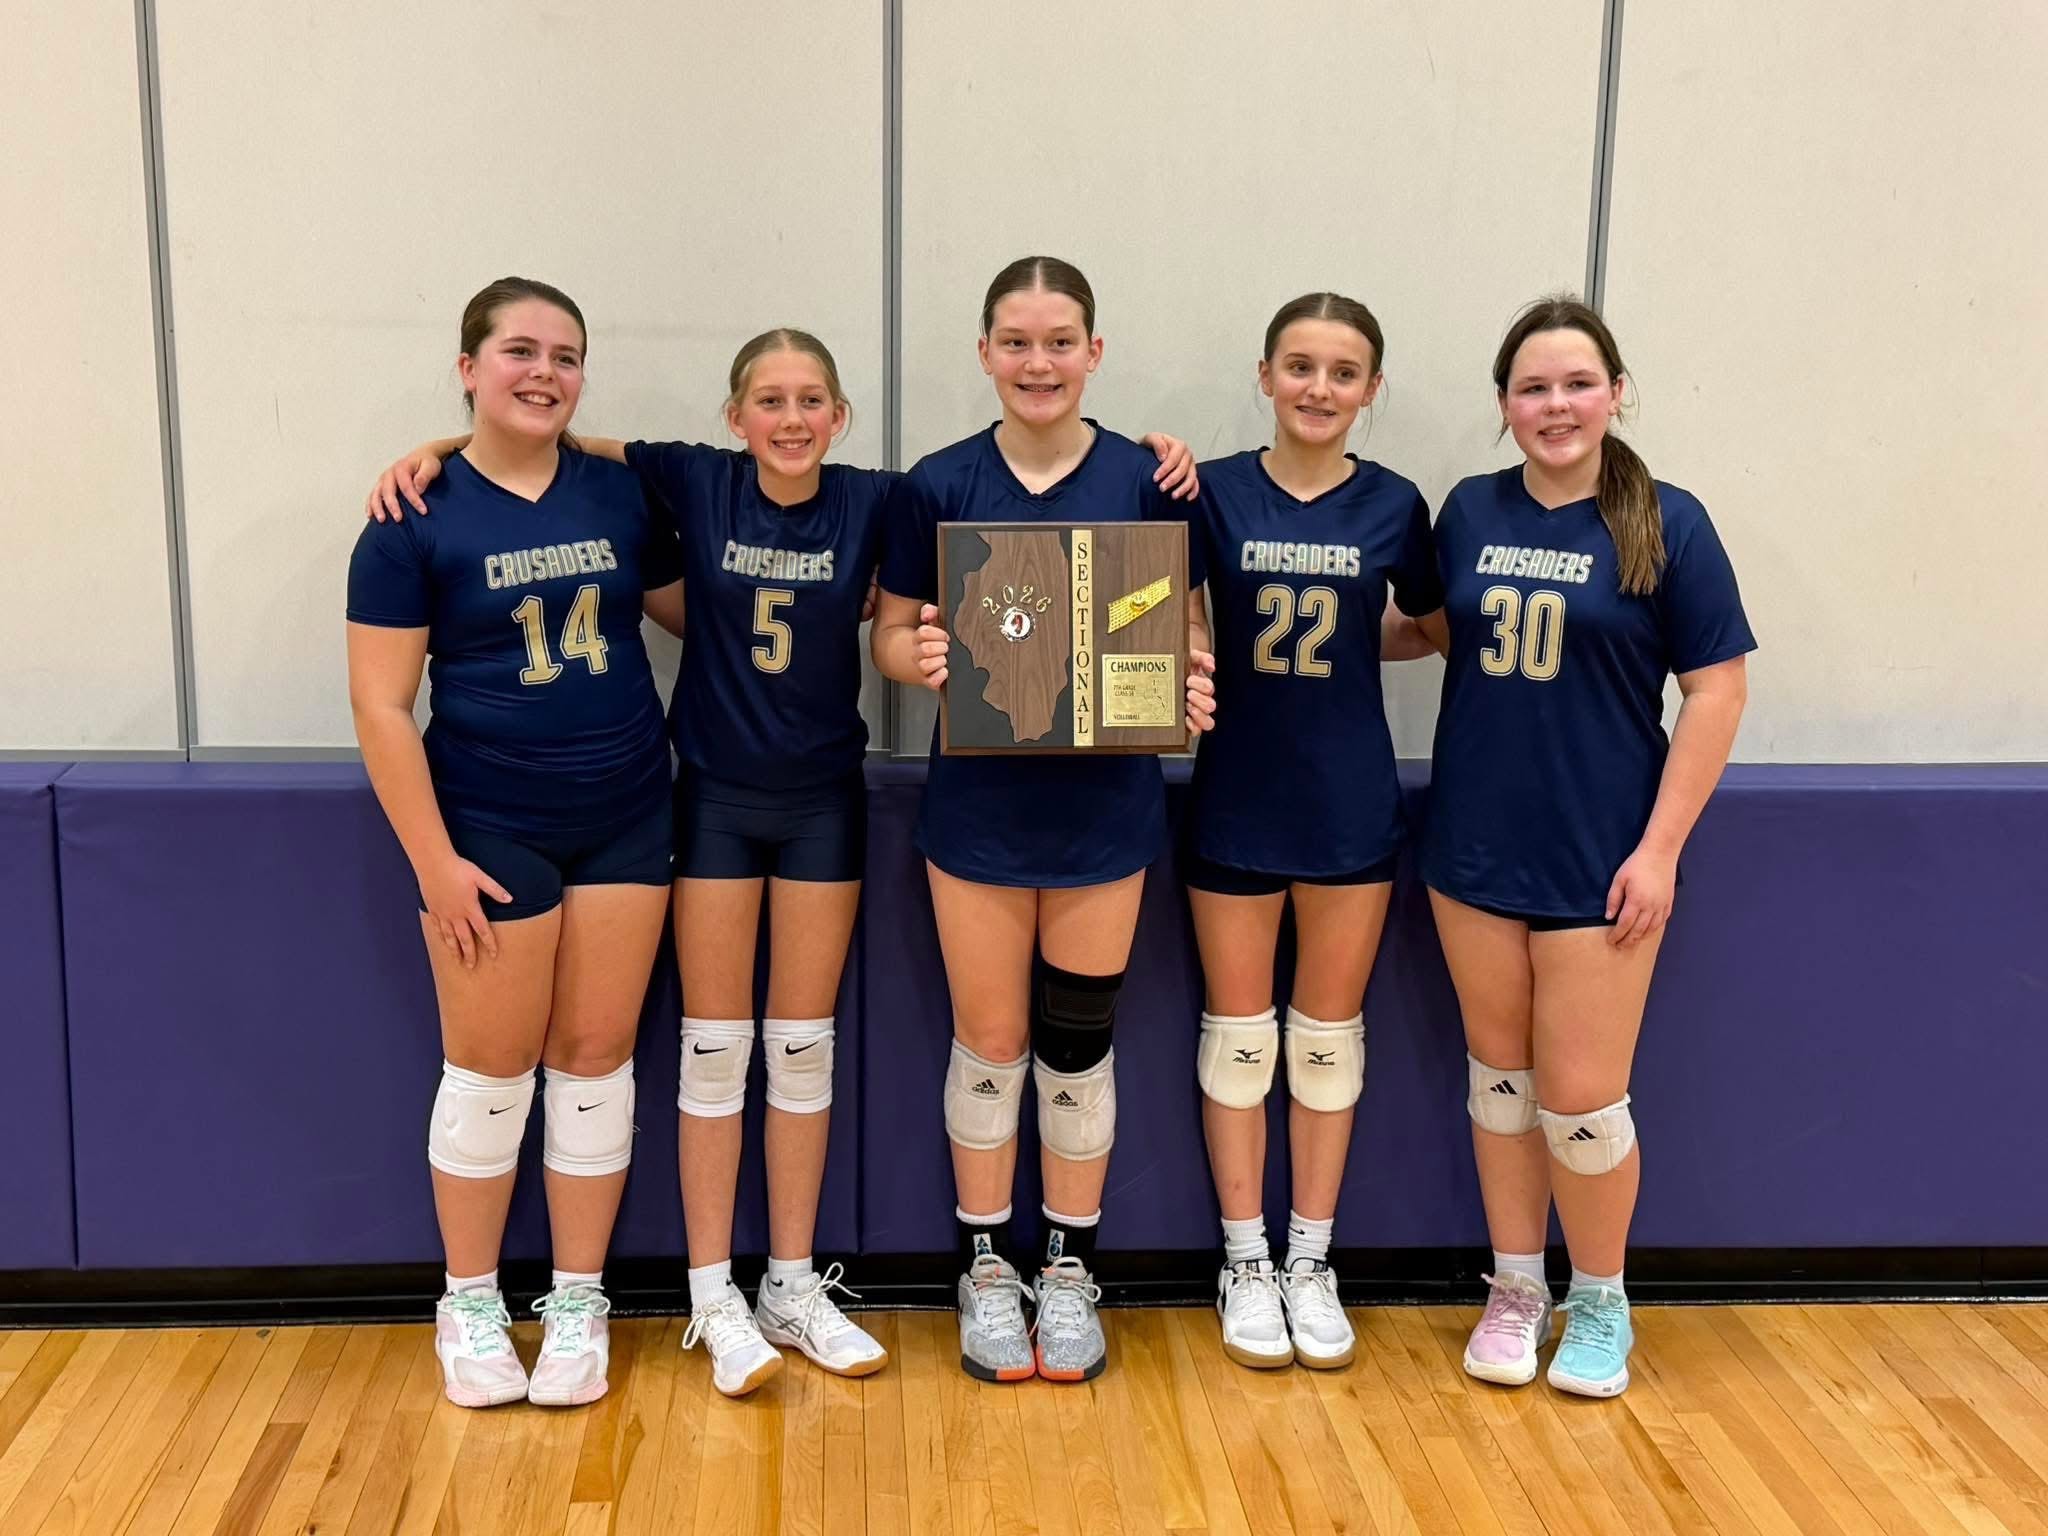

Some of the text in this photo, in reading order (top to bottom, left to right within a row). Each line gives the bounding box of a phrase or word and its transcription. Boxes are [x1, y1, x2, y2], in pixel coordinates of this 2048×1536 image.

[485, 538, 618, 590] CRUSADERS
[723, 539, 834, 581] CRUSADERS
[1240, 540, 1360, 578] CRUSADERS
[1476, 544, 1594, 584] CRUSADERS
[982, 584, 1052, 616] 2026
[511, 584, 608, 685] 14
[752, 587, 795, 674] 5
[1076, 542, 1090, 735] SECTIONAL
[1254, 583, 1338, 678] 22
[1480, 584, 1566, 681] 30
[1110, 661, 1167, 673] CHAMPIONS
[971, 1086, 1000, 1095] adidas
[1052, 1098, 1078, 1107] adidas
